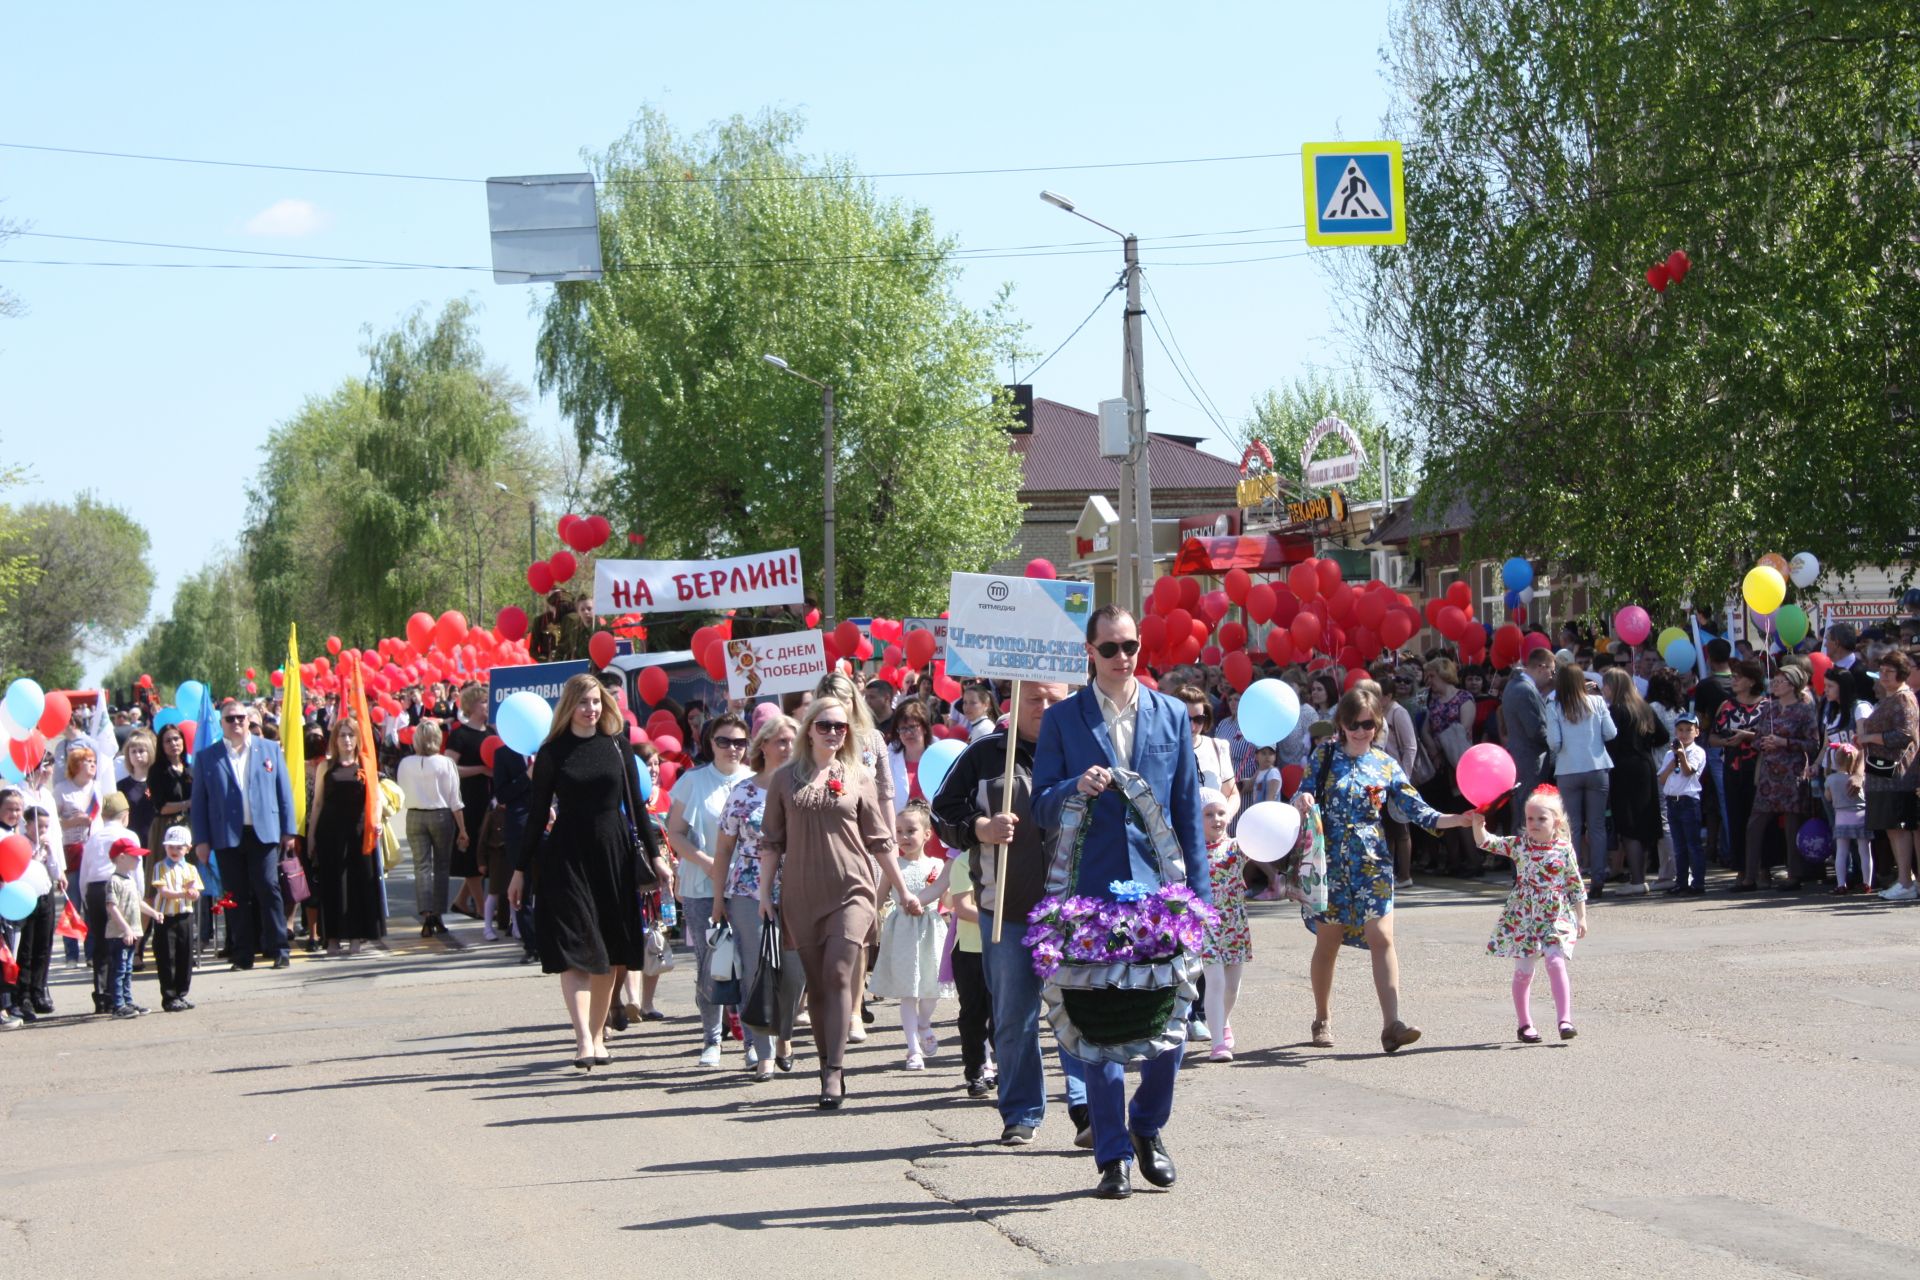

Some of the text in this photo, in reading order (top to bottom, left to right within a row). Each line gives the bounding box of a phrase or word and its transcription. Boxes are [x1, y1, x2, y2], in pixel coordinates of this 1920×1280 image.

[1287, 497, 1329, 523] ПЕКАРНЯ
[611, 554, 798, 608] НА БЕРЛИН!
[766, 643, 817, 661] С ДНЕМ
[988, 651, 1087, 673] ИЗВЕСТИЯ
[763, 660, 825, 678] ПОБЕДЫ!
